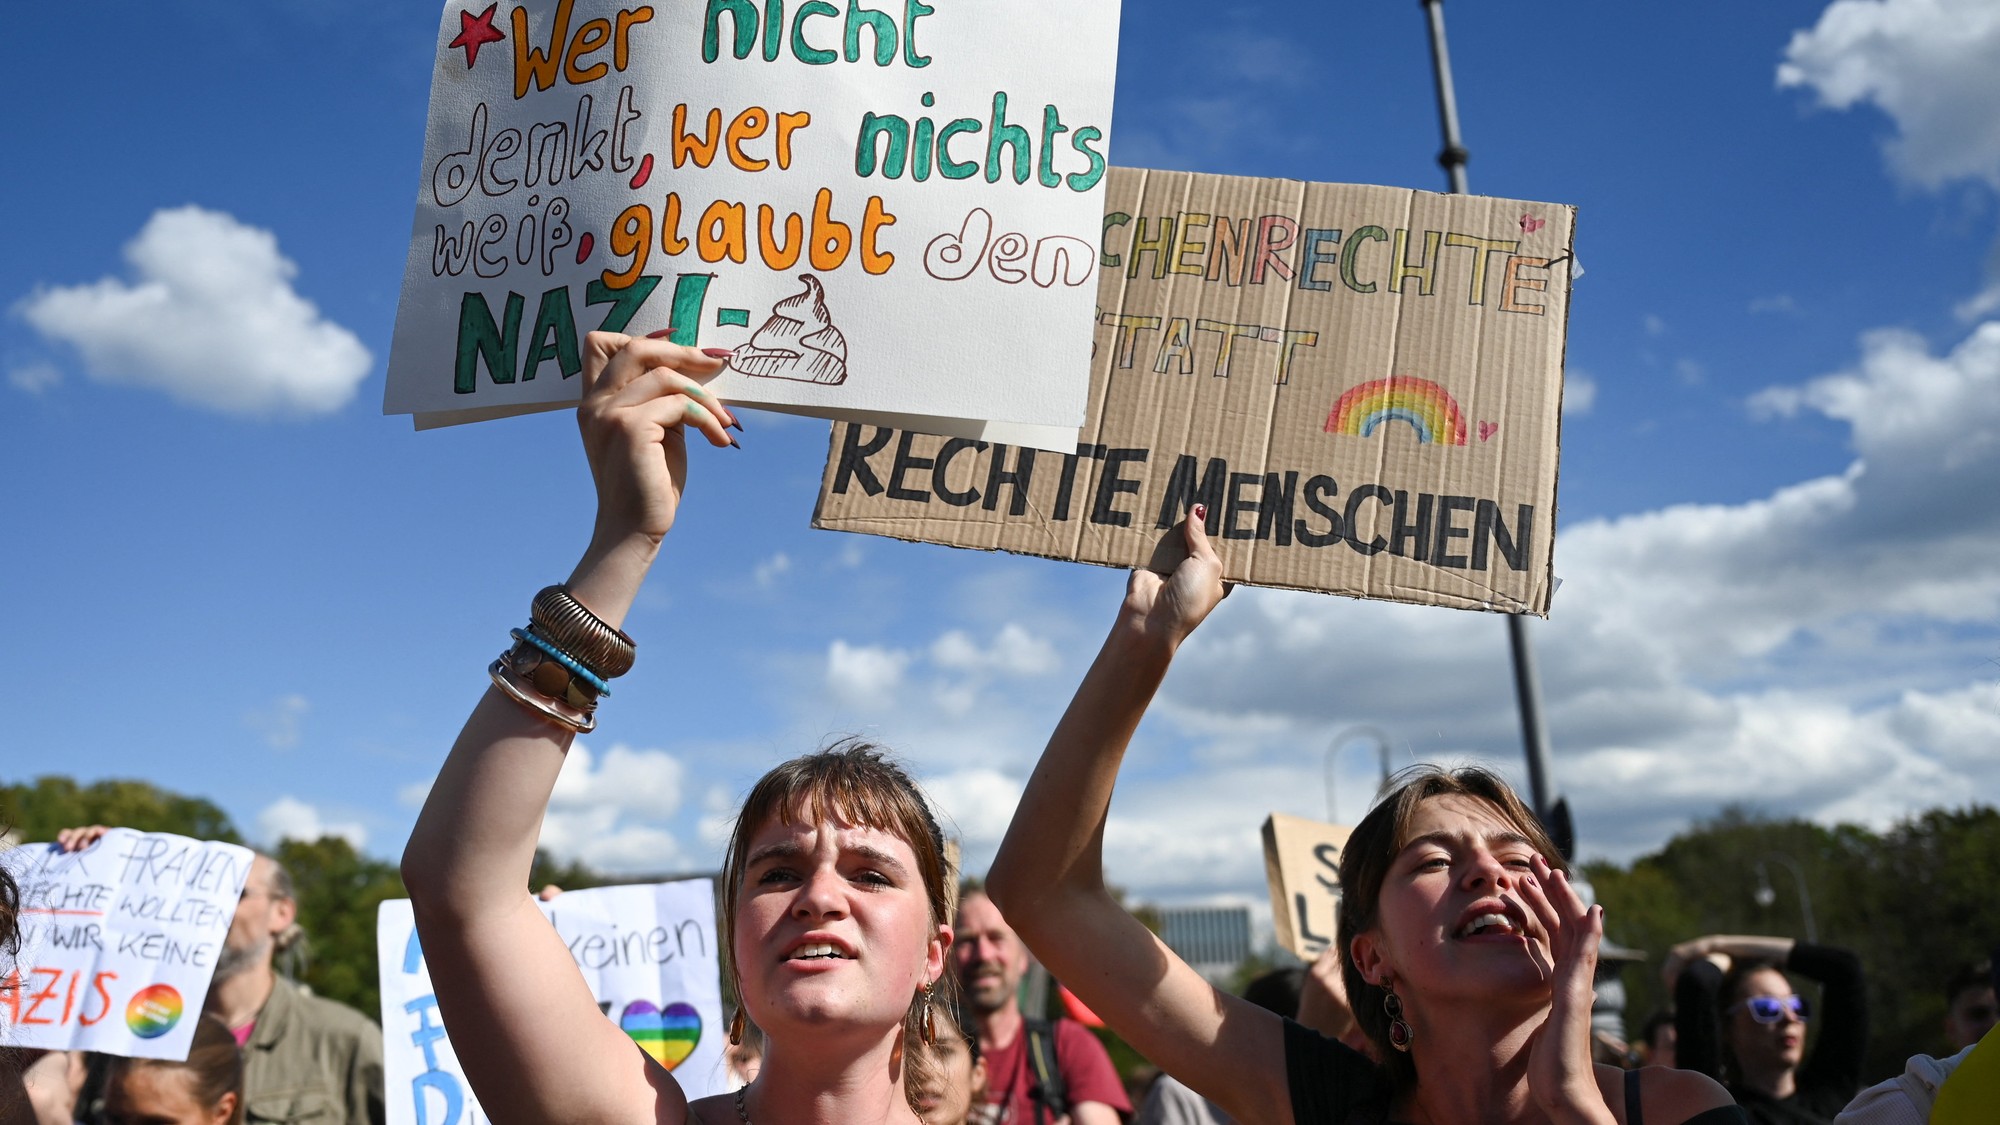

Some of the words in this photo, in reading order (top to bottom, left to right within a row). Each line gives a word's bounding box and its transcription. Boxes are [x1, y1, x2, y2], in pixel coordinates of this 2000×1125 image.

[511, 0, 654, 99] Wer
[702, 0, 935, 68] nicht
[433, 85, 654, 207] denkt,
[672, 102, 811, 172] wer
[855, 91, 1106, 192] nichts
[601, 188, 897, 289] glaubt
[924, 208, 1095, 287] den
[1091, 304, 1319, 386] TATT
[832, 422, 1148, 528] RECHTE
[1155, 453, 1534, 572] MENSCHEN
[24, 881, 113, 910] ECHTE
[120, 894, 232, 930] WOLLTEN
[119, 833, 251, 894] FRAUEN
[52, 923, 103, 952] WIR
[118, 932, 213, 967] KEINE
